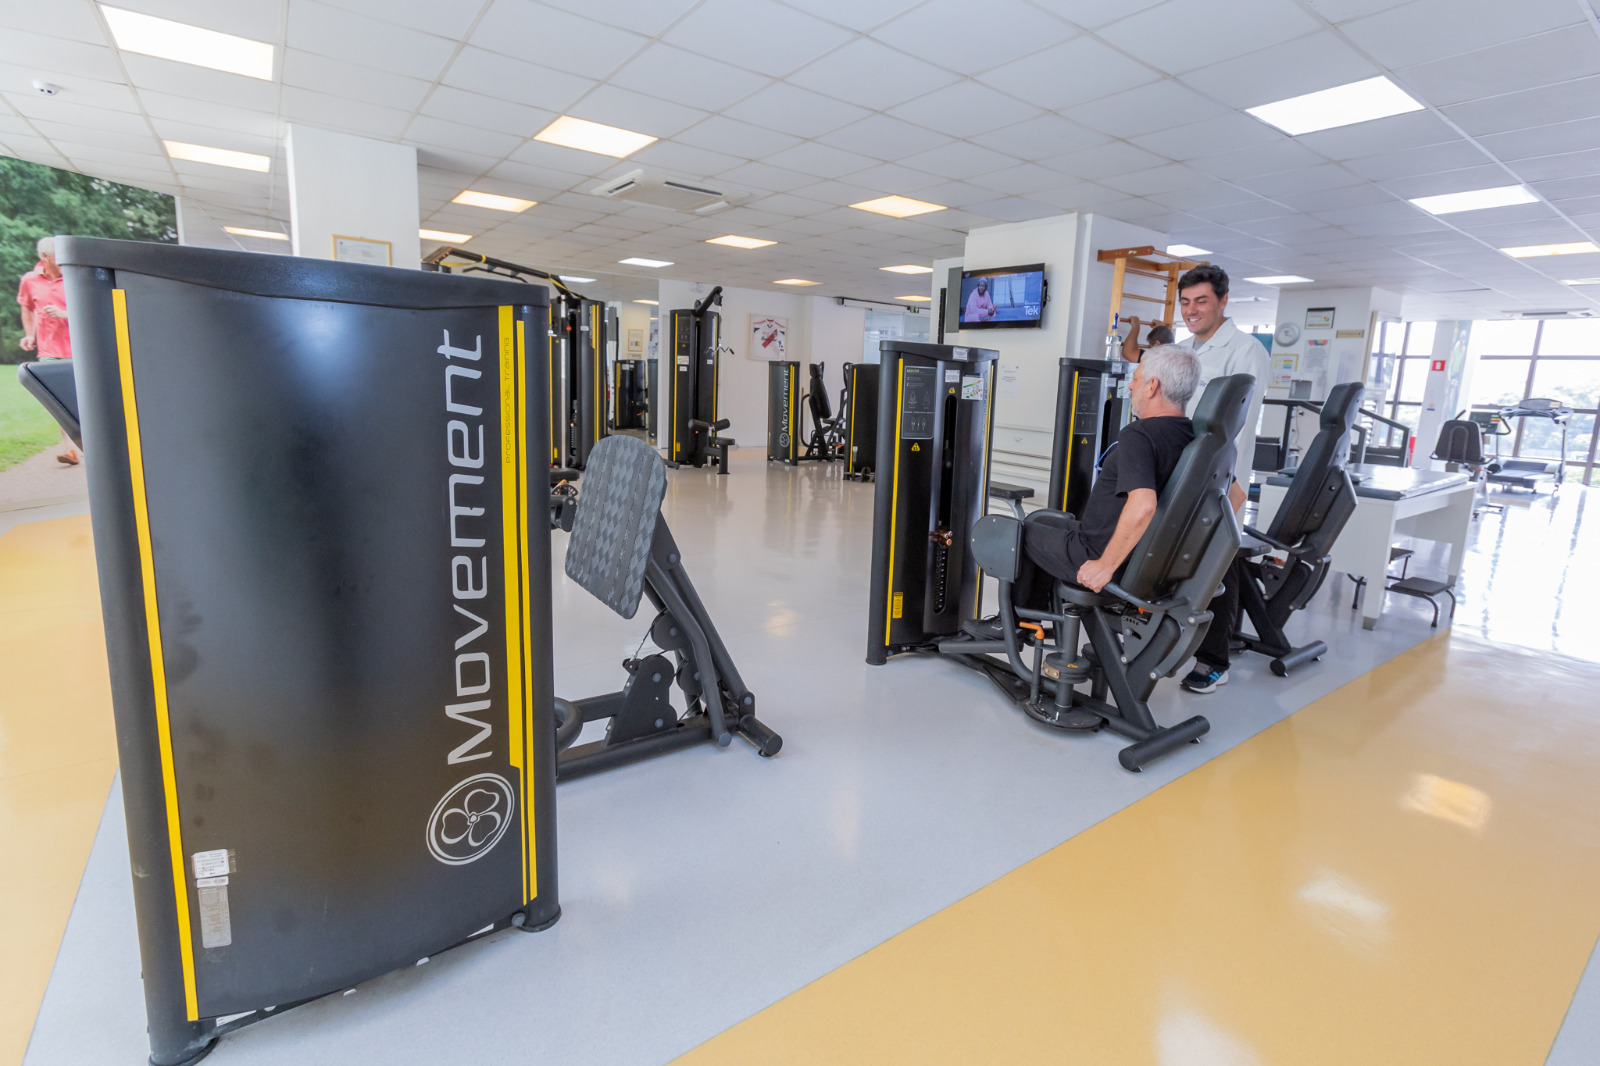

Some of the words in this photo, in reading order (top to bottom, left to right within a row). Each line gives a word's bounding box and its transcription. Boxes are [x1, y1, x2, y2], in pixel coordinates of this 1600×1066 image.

[1023, 305, 1039, 316] Tek
[781, 368, 789, 432] Movement
[437, 328, 493, 765] Movement
